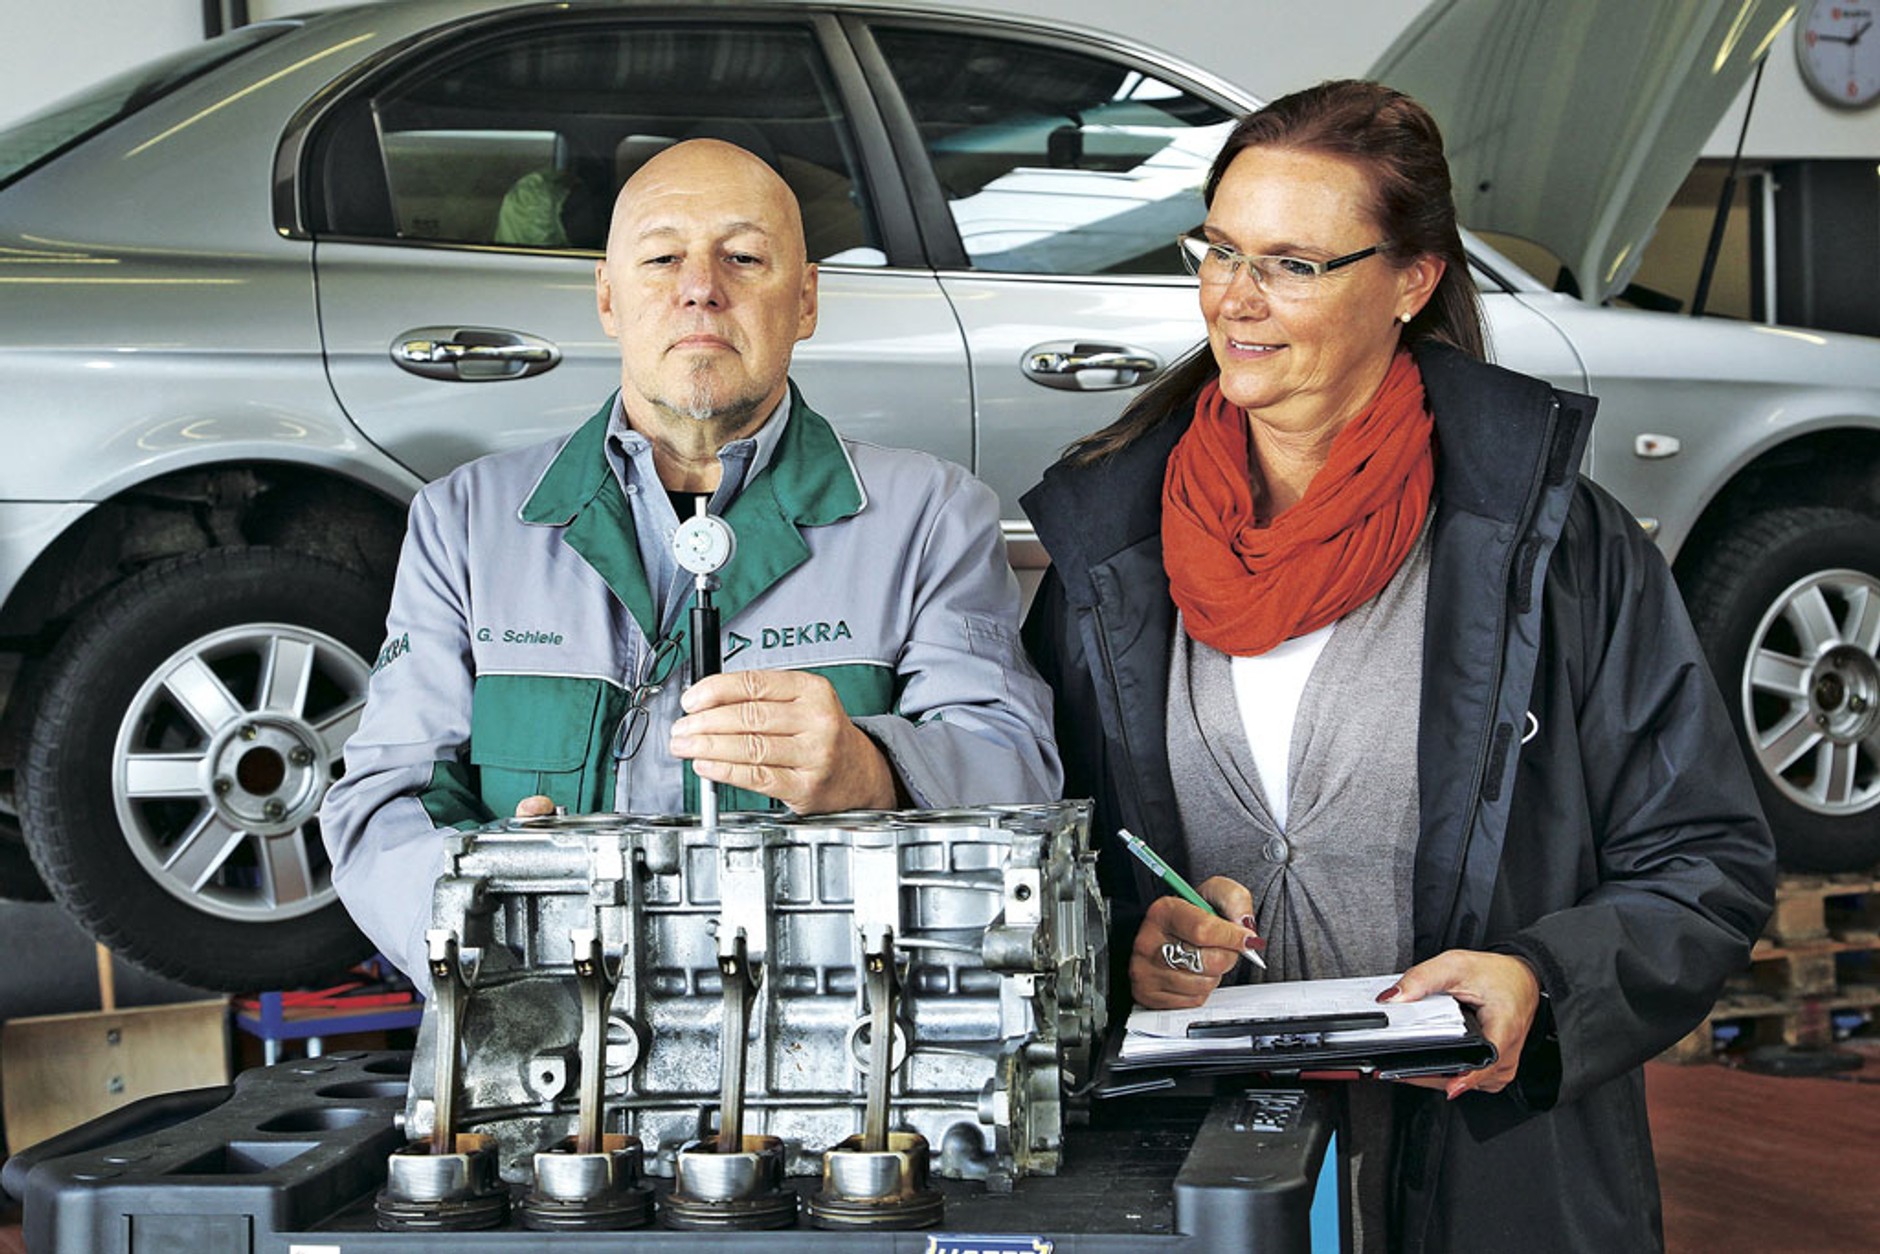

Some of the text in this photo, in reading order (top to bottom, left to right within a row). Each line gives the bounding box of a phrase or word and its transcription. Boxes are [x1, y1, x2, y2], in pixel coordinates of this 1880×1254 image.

[477, 627, 563, 645] G. Schiele
[762, 620, 852, 649] DEKRA
[371, 632, 411, 675] EKRA
